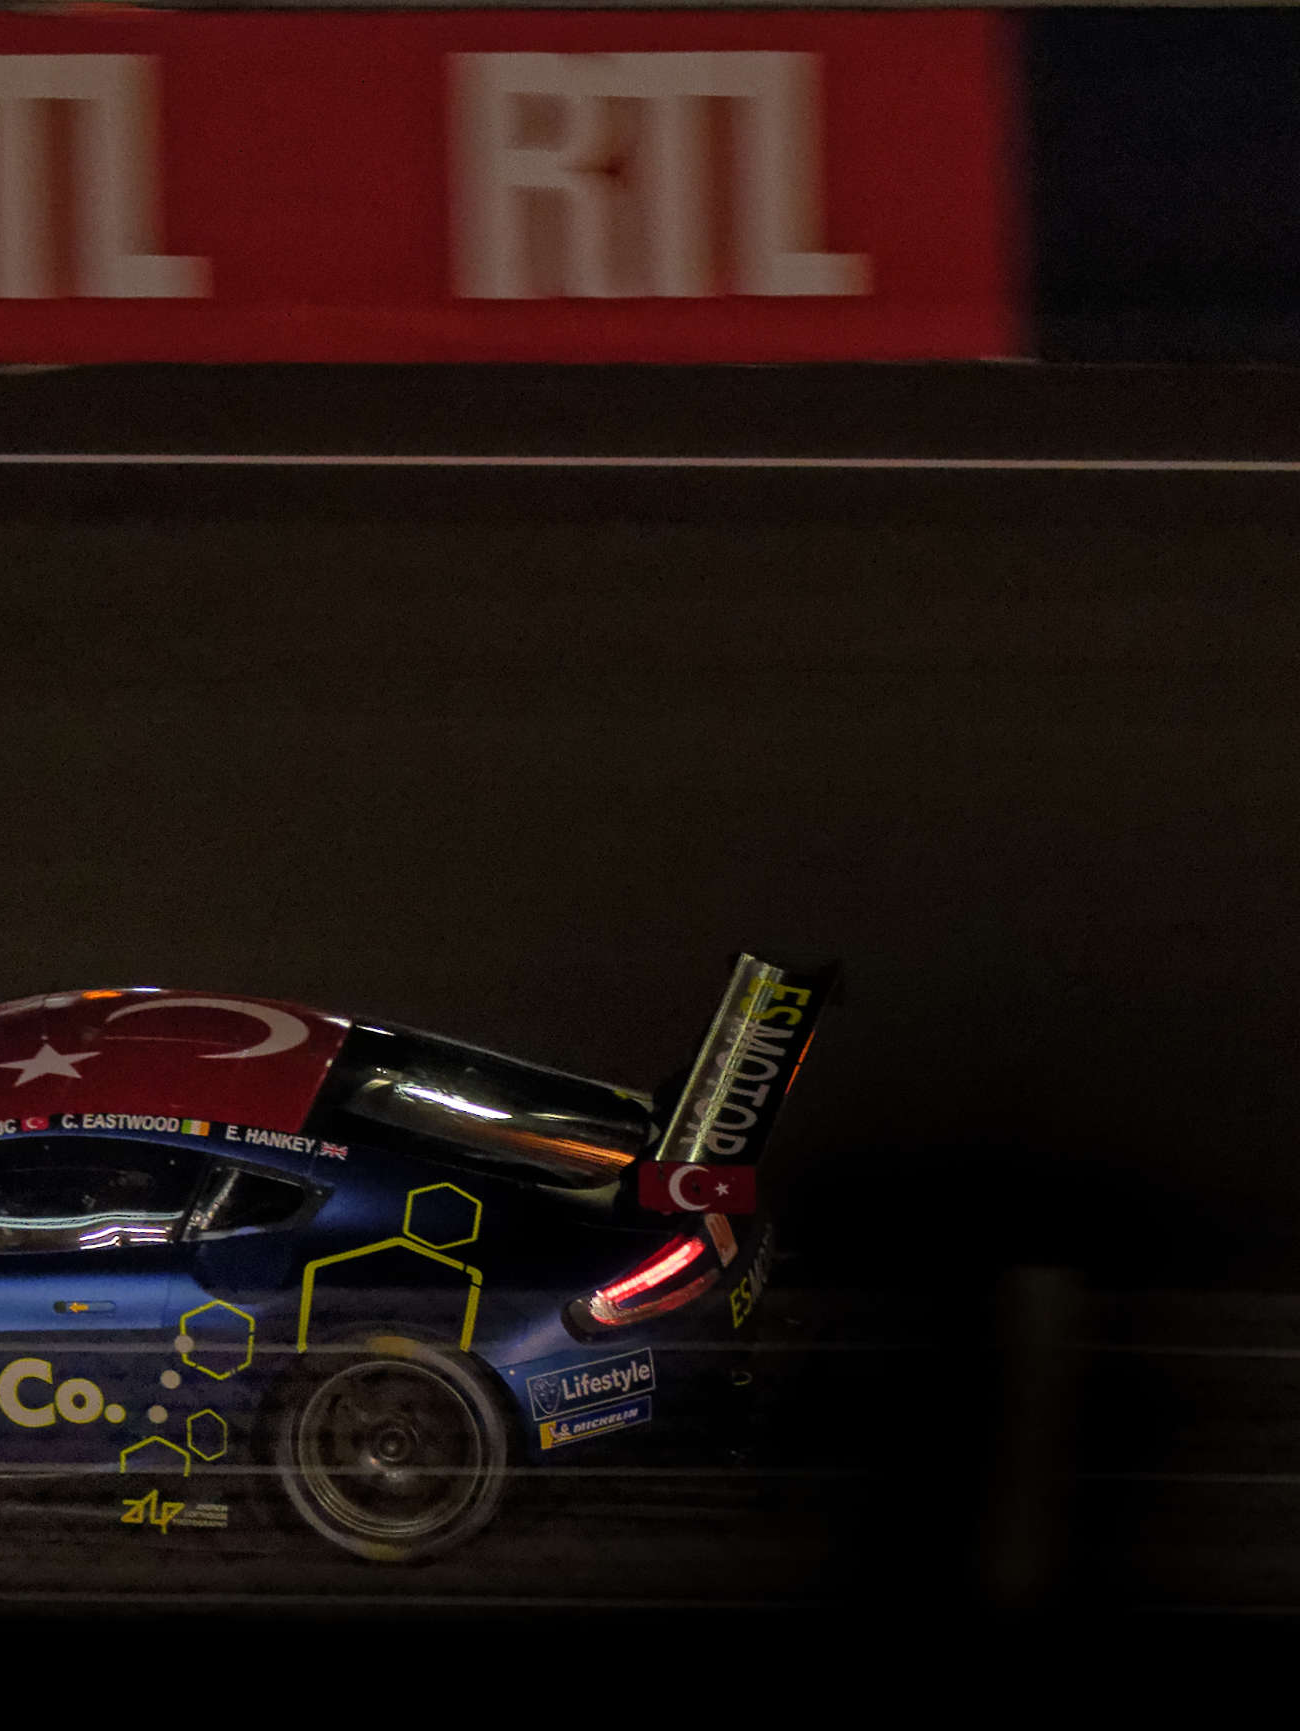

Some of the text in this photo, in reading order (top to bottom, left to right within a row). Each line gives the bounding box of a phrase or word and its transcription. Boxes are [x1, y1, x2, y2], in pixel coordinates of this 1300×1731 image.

[445, 50, 874, 299] RTL
[61, 1113, 181, 1133] C. EASTWOOD
[224, 1125, 317, 1154] E. HANKEY
[561, 1360, 651, 1401] Lifestyle
